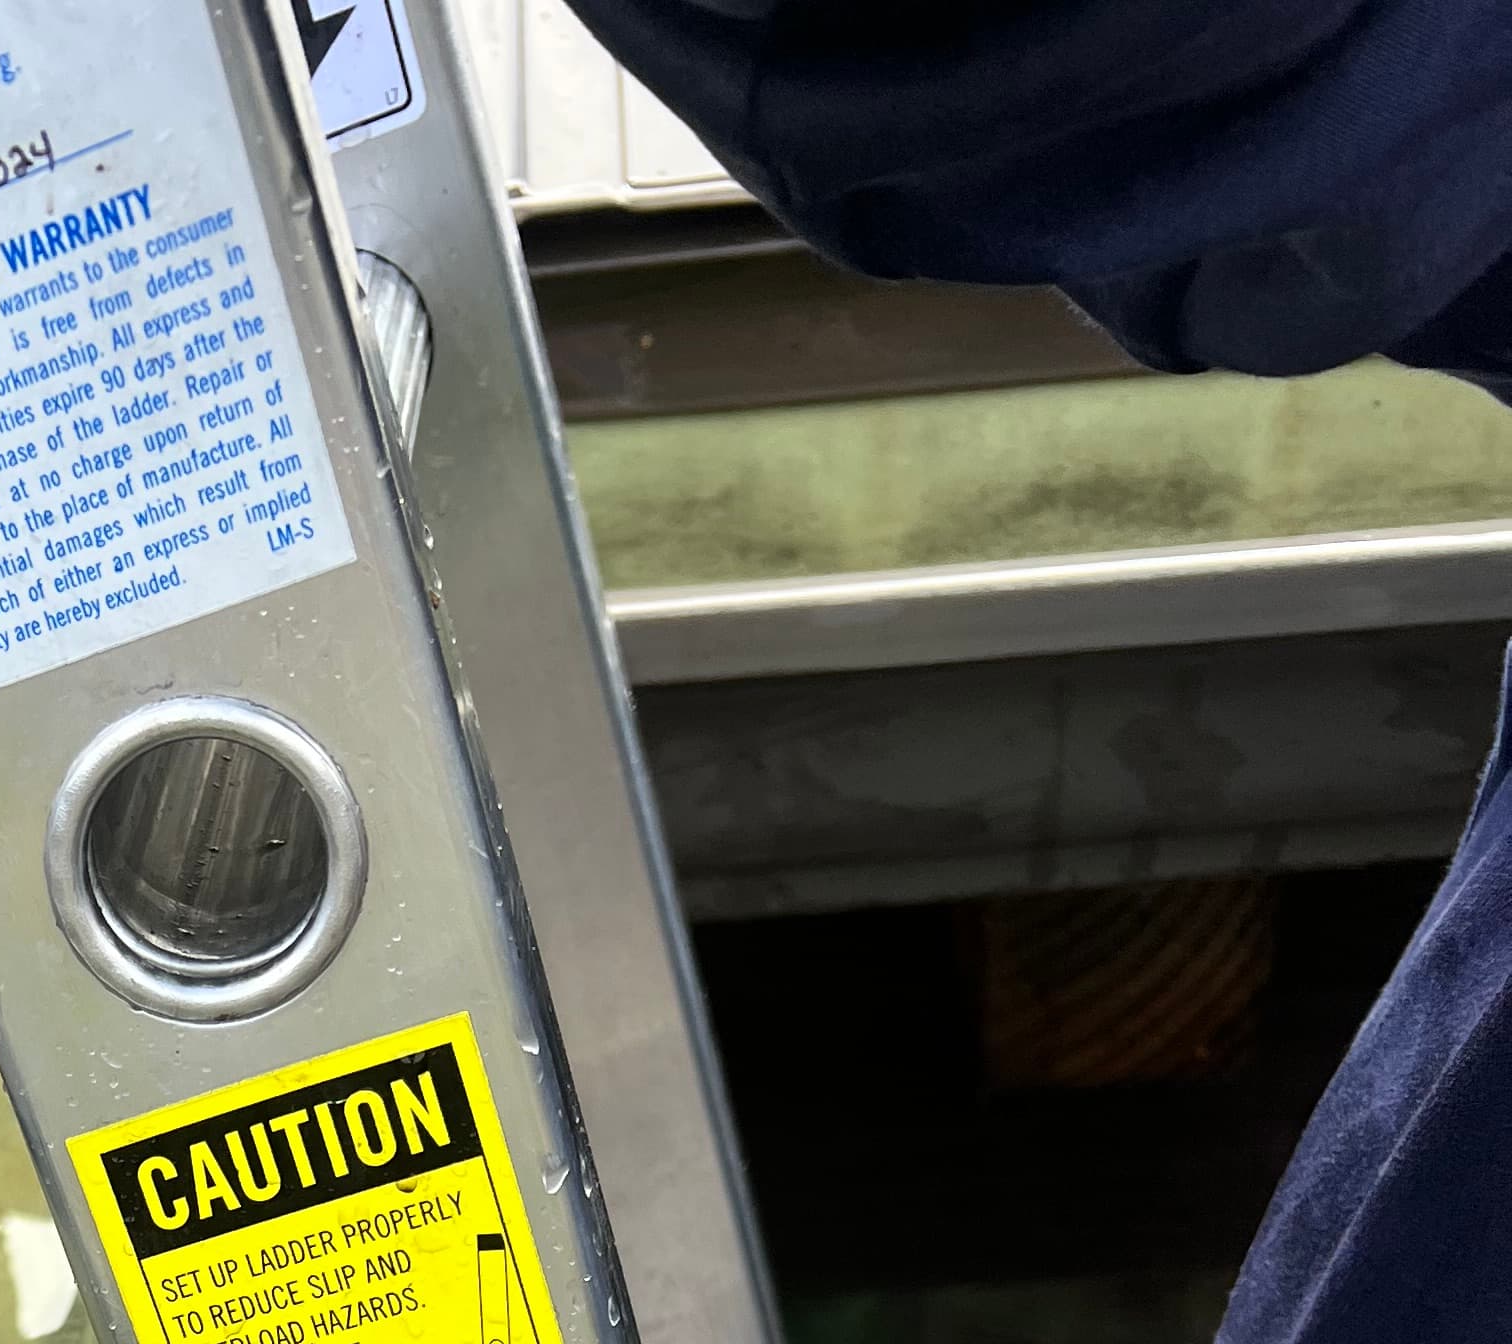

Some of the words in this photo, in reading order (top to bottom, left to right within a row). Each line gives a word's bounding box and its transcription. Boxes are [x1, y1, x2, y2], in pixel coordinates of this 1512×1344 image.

[83, 261, 102, 283] to
[107, 247, 139, 273] the
[145, 208, 232, 259] consumer
[10, 328, 29, 351] is
[41, 312, 77, 339] free
[88, 290, 132, 320] from
[146, 257, 213, 298] defects
[226, 245, 244, 266] in
[111, 322, 135, 351] All
[143, 298, 211, 338] express
[219, 274, 254, 309] and
[42, 382, 94, 416] expire
[100, 365, 125, 392] 90
[133, 351, 175, 381] days
[183, 330, 224, 362] after
[233, 315, 264, 341] the
[46, 425, 63, 451] of
[73, 416, 103, 441] the
[111, 390, 175, 426] ladder.
[184, 359, 244, 398] Repair
[255, 350, 271, 371] or
[0, 521, 18, 541] to
[24, 508, 54, 532] the
[61, 488, 109, 523] place
[116, 472, 133, 498] of
[142, 434, 261, 489] manufacture.
[270, 414, 292, 443] All
[9, 477, 29, 502] at
[39, 470, 60, 491] no
[71, 443, 132, 479] charge
[143, 422, 187, 453] upon
[199, 397, 253, 431] return
[265, 378, 282, 405] of
[28, 577, 44, 602] of
[53, 561, 101, 592] either
[112, 551, 134, 573] an
[143, 524, 209, 560] express
[218, 513, 233, 534] or
[243, 481, 311, 523] implied
[44, 520, 123, 561] damages
[133, 493, 186, 528] which
[197, 469, 249, 505] result
[259, 454, 301, 482] from
[266, 517, 313, 552] LM-S
[14, 620, 41, 641] are
[43, 598, 100, 630] hereby
[105, 564, 186, 609] excluded.
[136, 1070, 451, 1230] CAUTION
[160, 1268, 202, 1302] SET
[207, 1258, 238, 1288] UP
[244, 1229, 337, 1277] LADDER
[340, 1190, 461, 1248] PROPERLY
[171, 1310, 204, 1338] TO
[208, 1279, 304, 1329] REDUCE
[306, 1264, 355, 1299] SLIP
[365, 1248, 411, 1283] AND
[309, 1286, 425, 1338] HAZARDS.
